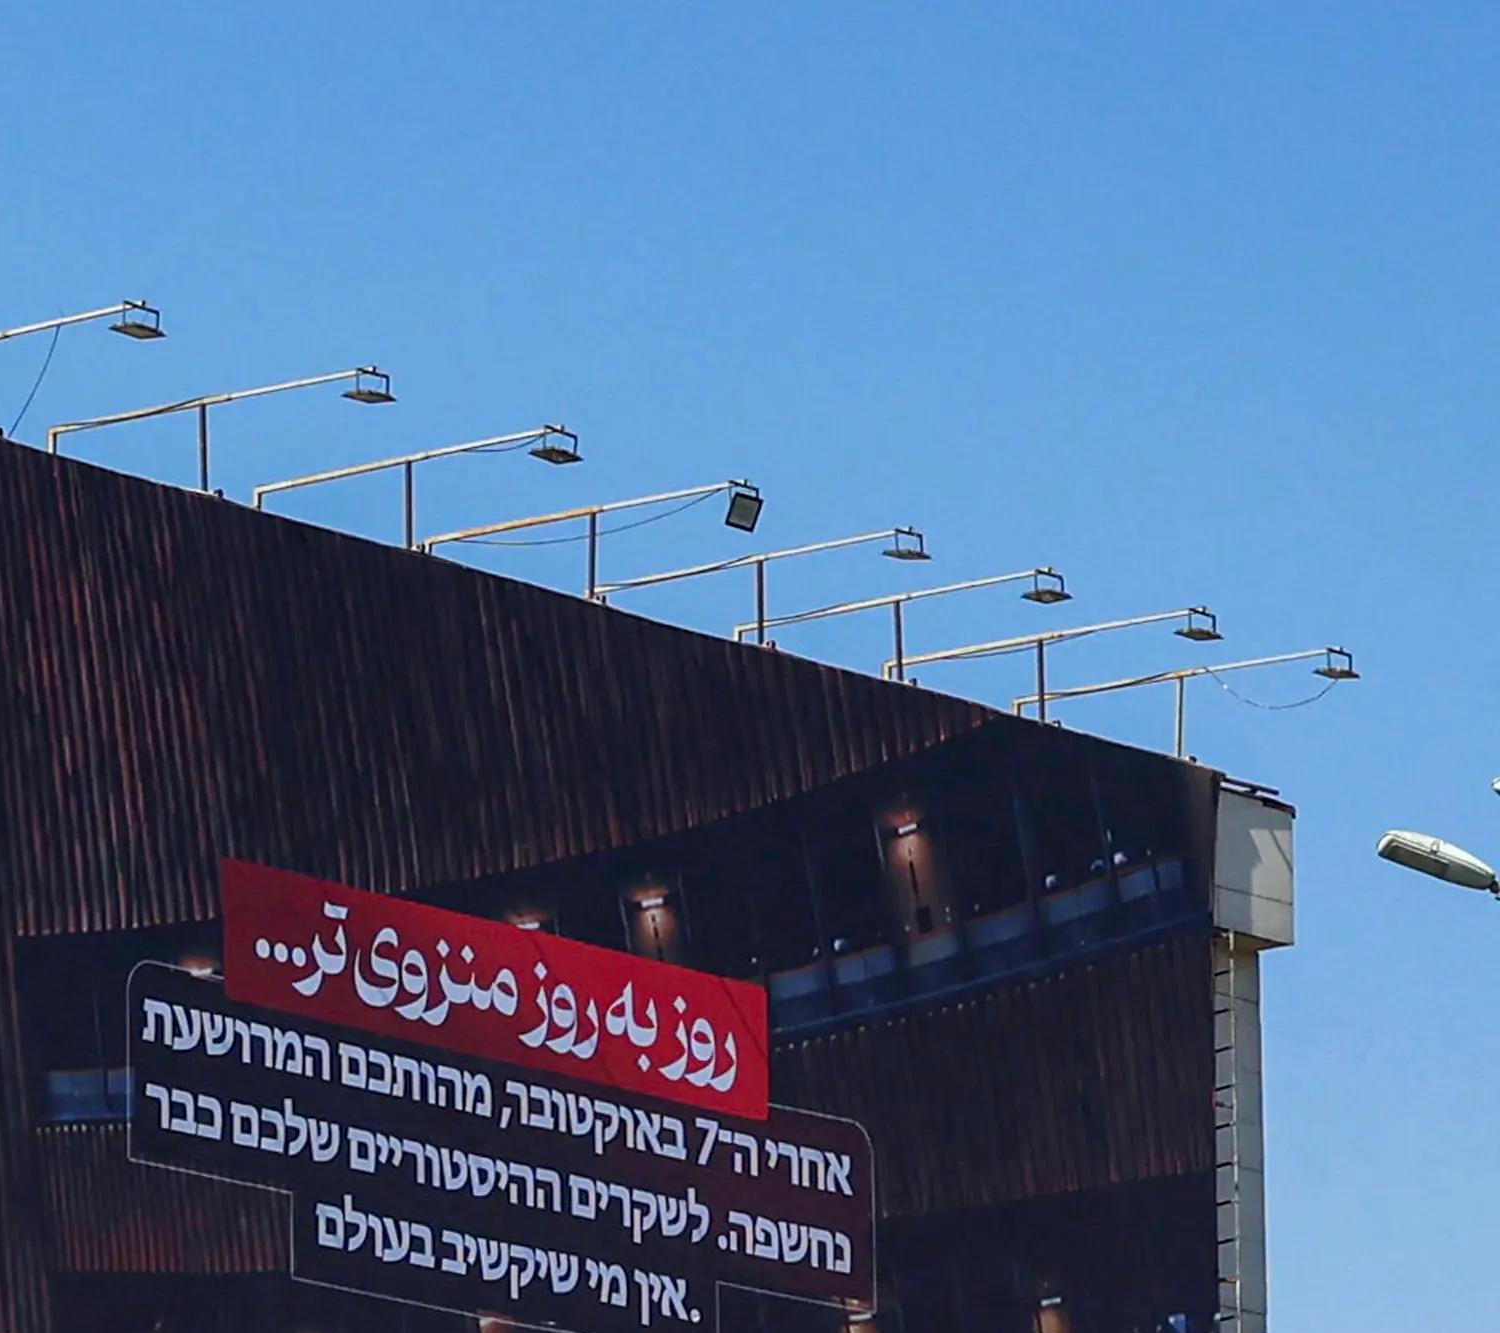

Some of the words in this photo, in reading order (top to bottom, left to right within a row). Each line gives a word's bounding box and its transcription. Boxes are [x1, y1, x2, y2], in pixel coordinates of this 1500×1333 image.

[354, 923, 520, 1027] منزوی
[518, 960, 600, 1061] روز
[140, 995, 332, 1082] המרושעת
[606, 980, 657, 1073] به
[657, 993, 739, 1094] روز
[145, 1080, 222, 1141] כבר
[337, 1038, 492, 1119] מהותכם
[230, 1097, 341, 1164] שלכם
[500, 1077, 688, 1163] באוקטובר,
[347, 1126, 563, 1212] ההיסטוריים
[765, 1136, 853, 1197] אחרי
[314, 1195, 435, 1272] בעולם
[566, 1172, 710, 1247] לשקרים
[716, 1208, 851, 1274] נחשפה.
[439, 1227, 580, 1301] שיקשיב
[583, 1257, 629, 1306] מי
